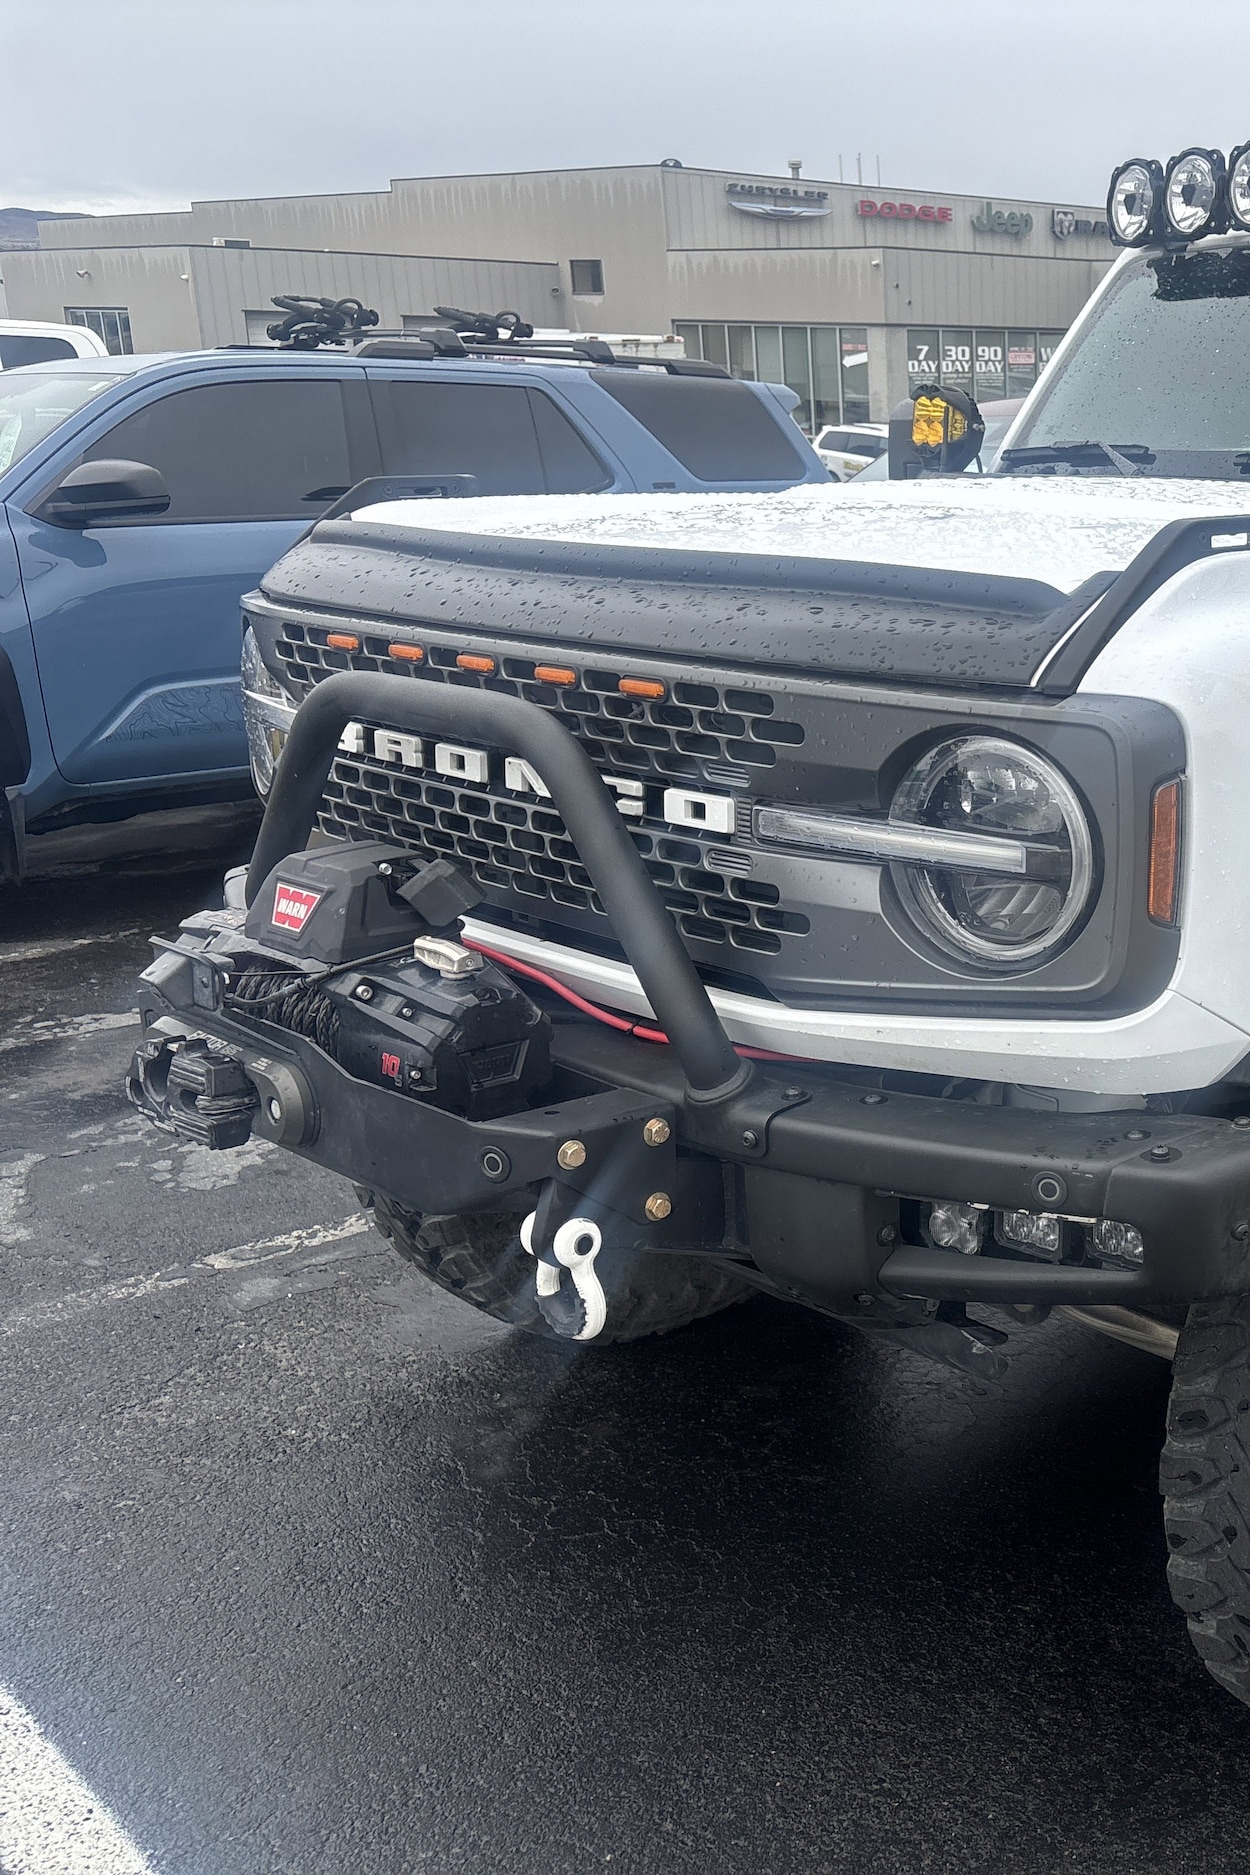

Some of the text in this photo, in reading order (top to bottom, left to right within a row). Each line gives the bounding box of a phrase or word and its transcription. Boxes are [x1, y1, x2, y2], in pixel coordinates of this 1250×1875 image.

[858, 200, 953, 221] DODGE
[973, 201, 1033, 237] Jeep
[916, 345, 929, 360] 7
[945, 346, 970, 360] 30
[977, 346, 1002, 361] 90
[908, 360, 938, 373] DAY
[942, 360, 971, 373] DAY
[976, 361, 1004, 373] DAY
[277, 898, 308, 920] WARN
[381, 1052, 401, 1078] 10
